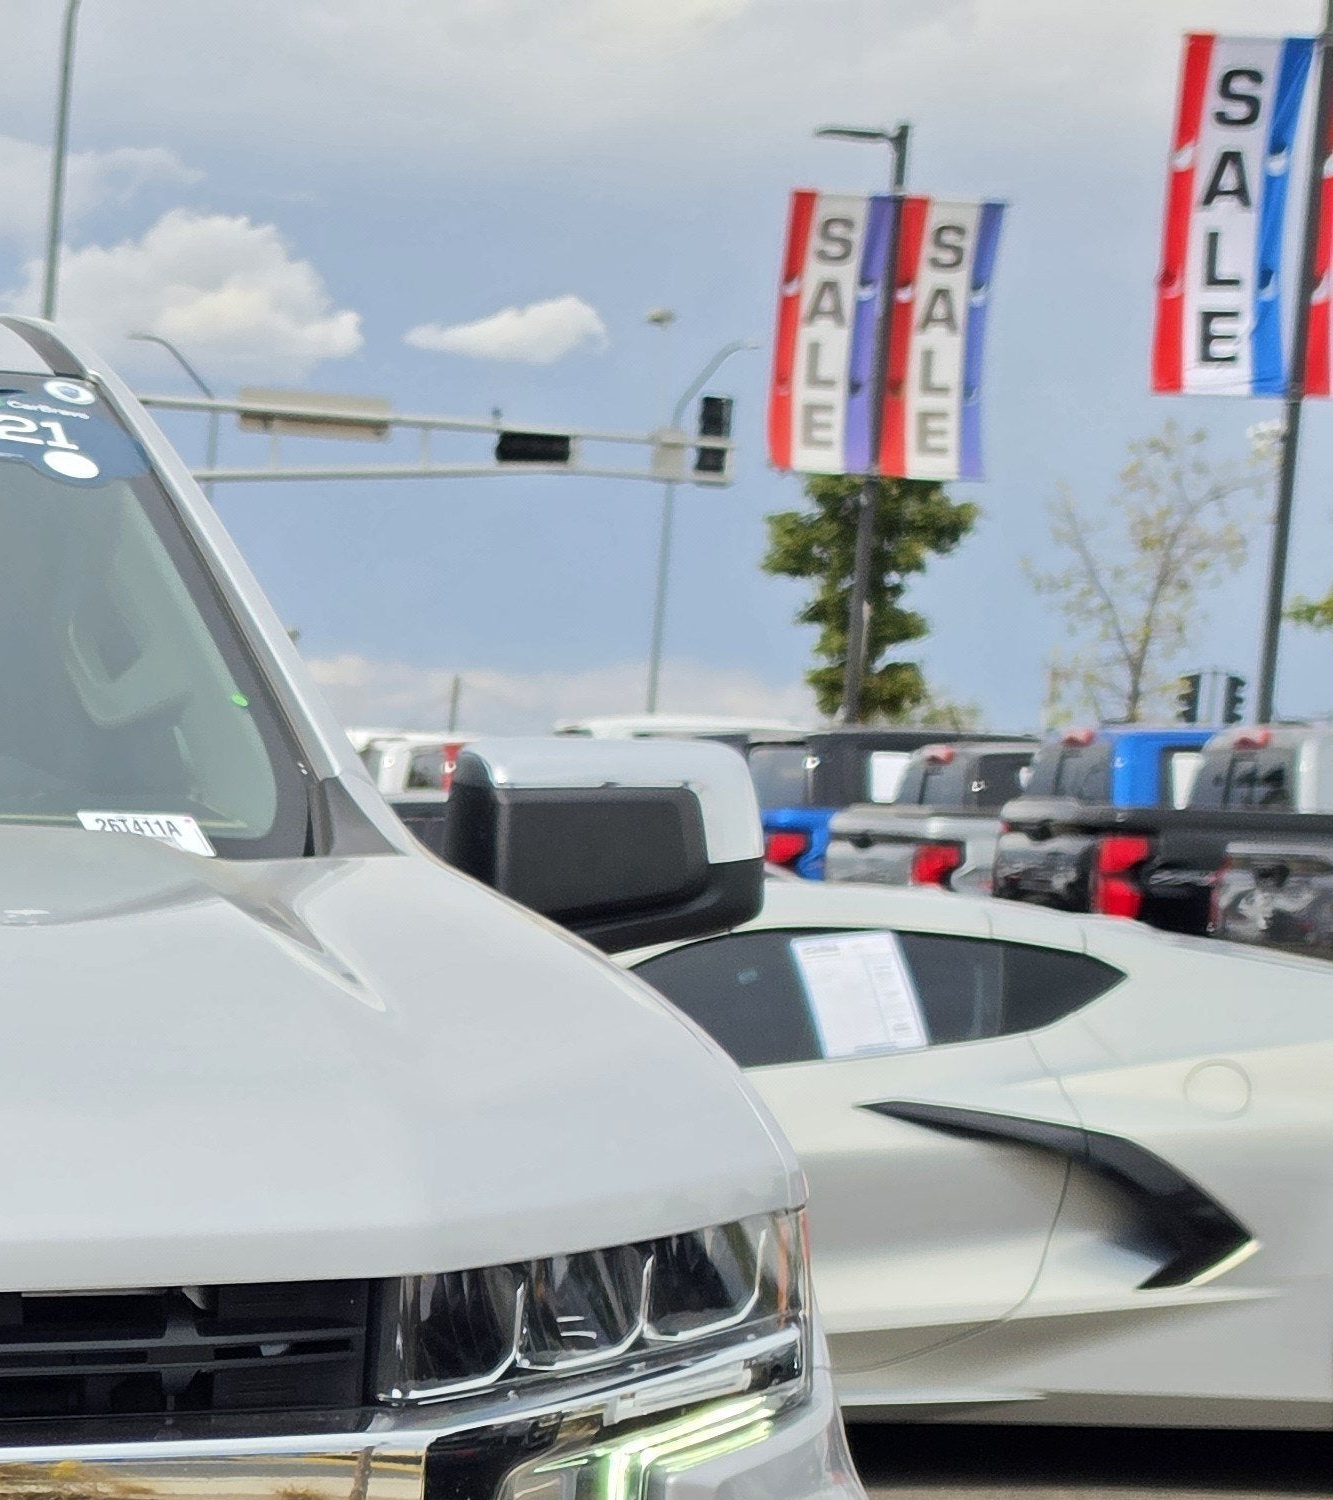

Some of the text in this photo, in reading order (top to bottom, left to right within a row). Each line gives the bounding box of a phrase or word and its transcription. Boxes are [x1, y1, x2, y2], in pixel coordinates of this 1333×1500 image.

[1201, 69, 1264, 364] SALE
[802, 217, 854, 450] SALE
[917, 225, 965, 456] SALE
[94, 818, 182, 837] 26T411A
